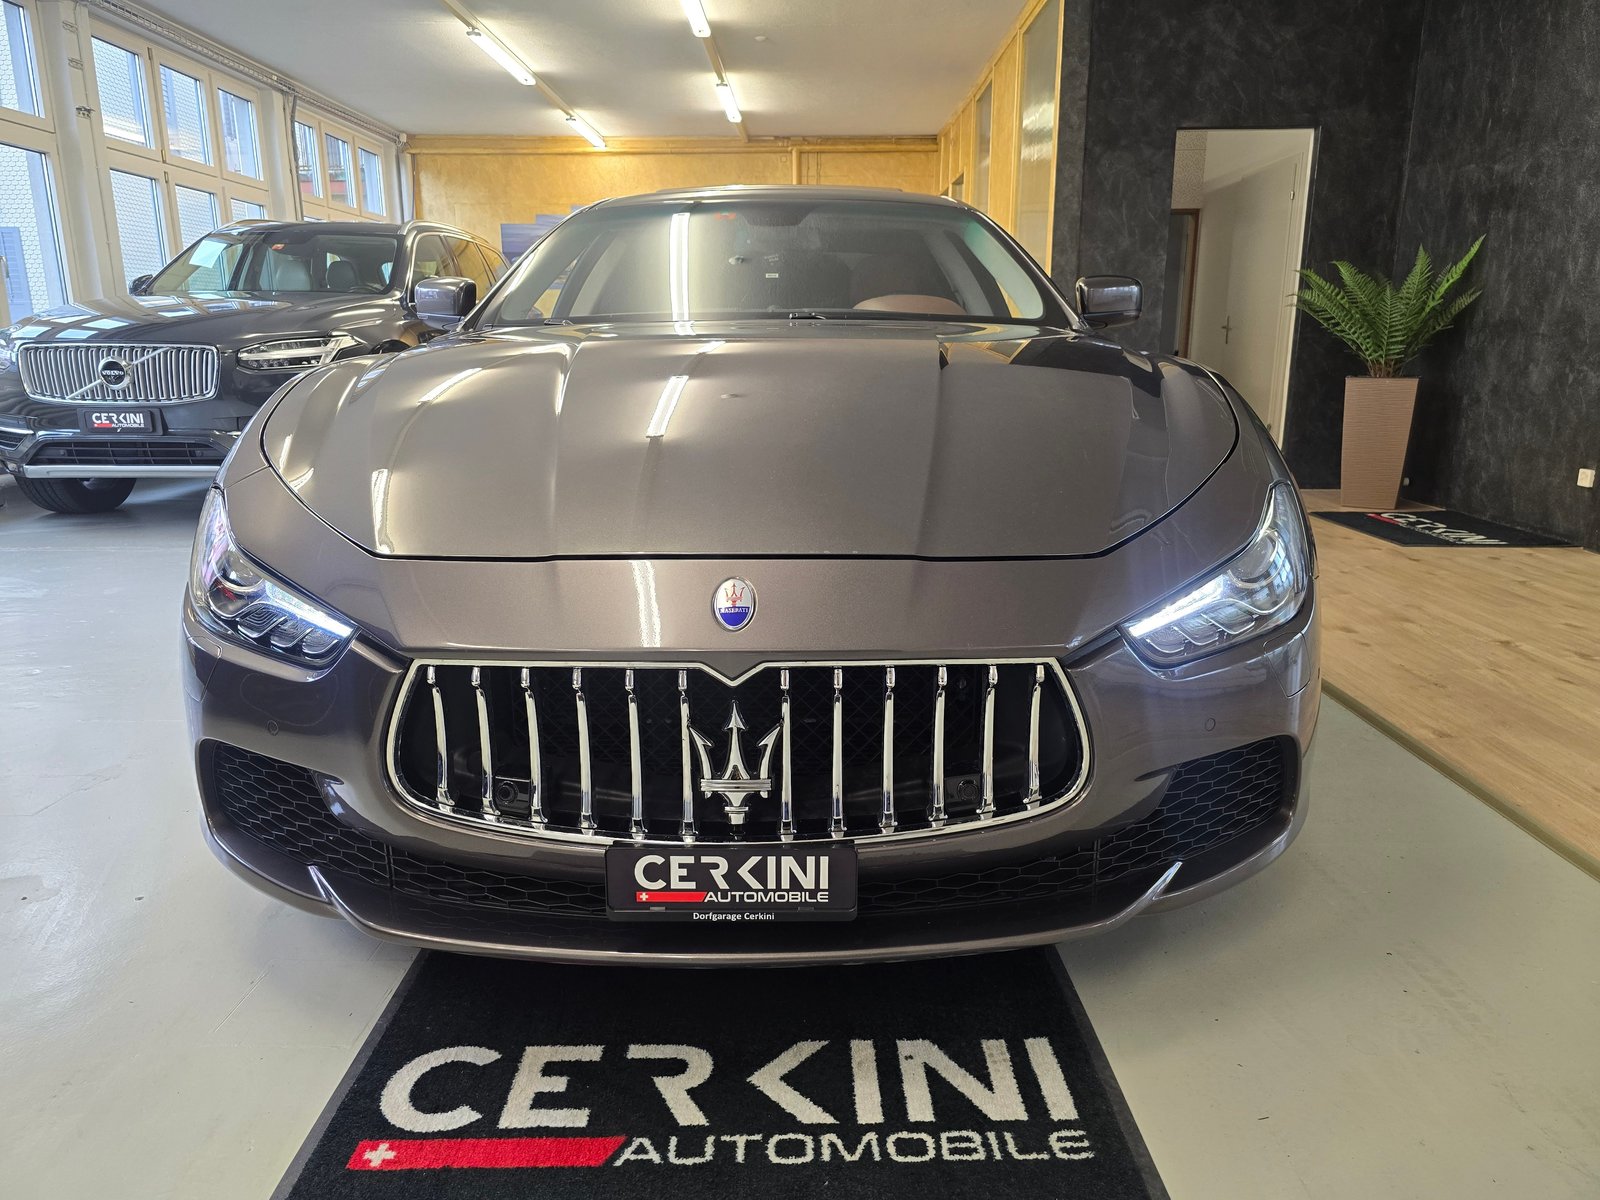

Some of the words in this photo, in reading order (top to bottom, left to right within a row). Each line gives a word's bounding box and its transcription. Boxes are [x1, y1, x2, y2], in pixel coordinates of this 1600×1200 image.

[92, 412, 144, 424] CERKINI
[634, 855, 829, 890] CERKINI
[703, 891, 829, 903] AUTOMOBILE
[692, 912, 742, 921] Dorfgarage
[744, 912, 775, 920] Cerkini
[379, 1037, 1079, 1133] CERKINI
[613, 1129, 1095, 1166] AUTOMOBILE
